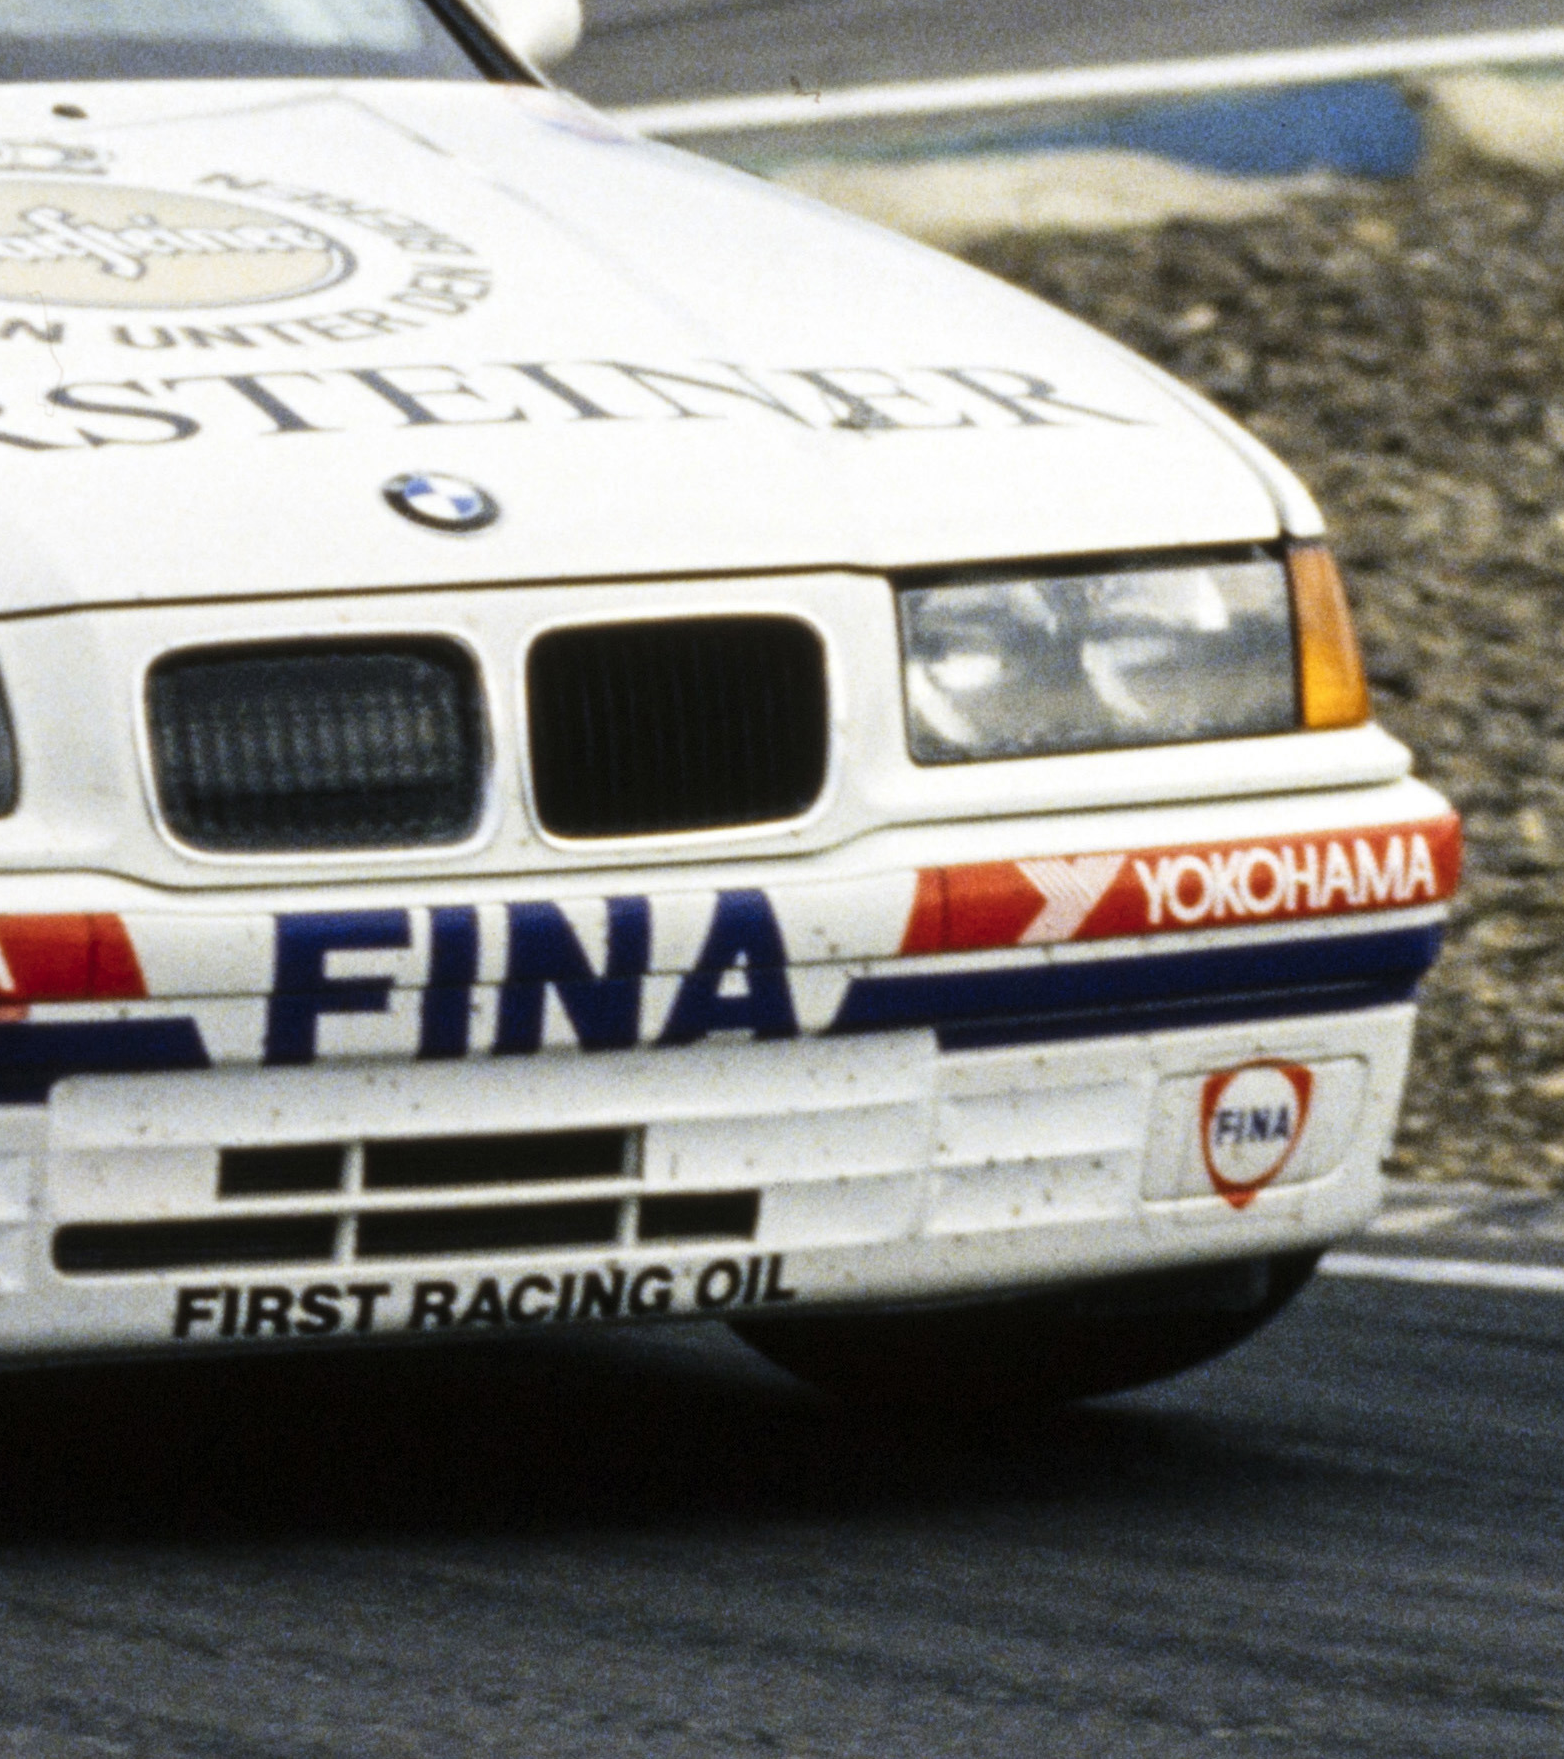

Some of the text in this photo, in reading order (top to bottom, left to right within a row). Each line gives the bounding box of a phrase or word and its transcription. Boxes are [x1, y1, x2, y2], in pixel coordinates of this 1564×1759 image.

[108, 307, 427, 350] UNTER
[1133, 833, 1439, 926] YOKOHAMA
[261, 886, 802, 1068] FINA
[1216, 1103, 1292, 1146] FINA
[172, 1250, 800, 1338] FIRST RACING OIL
